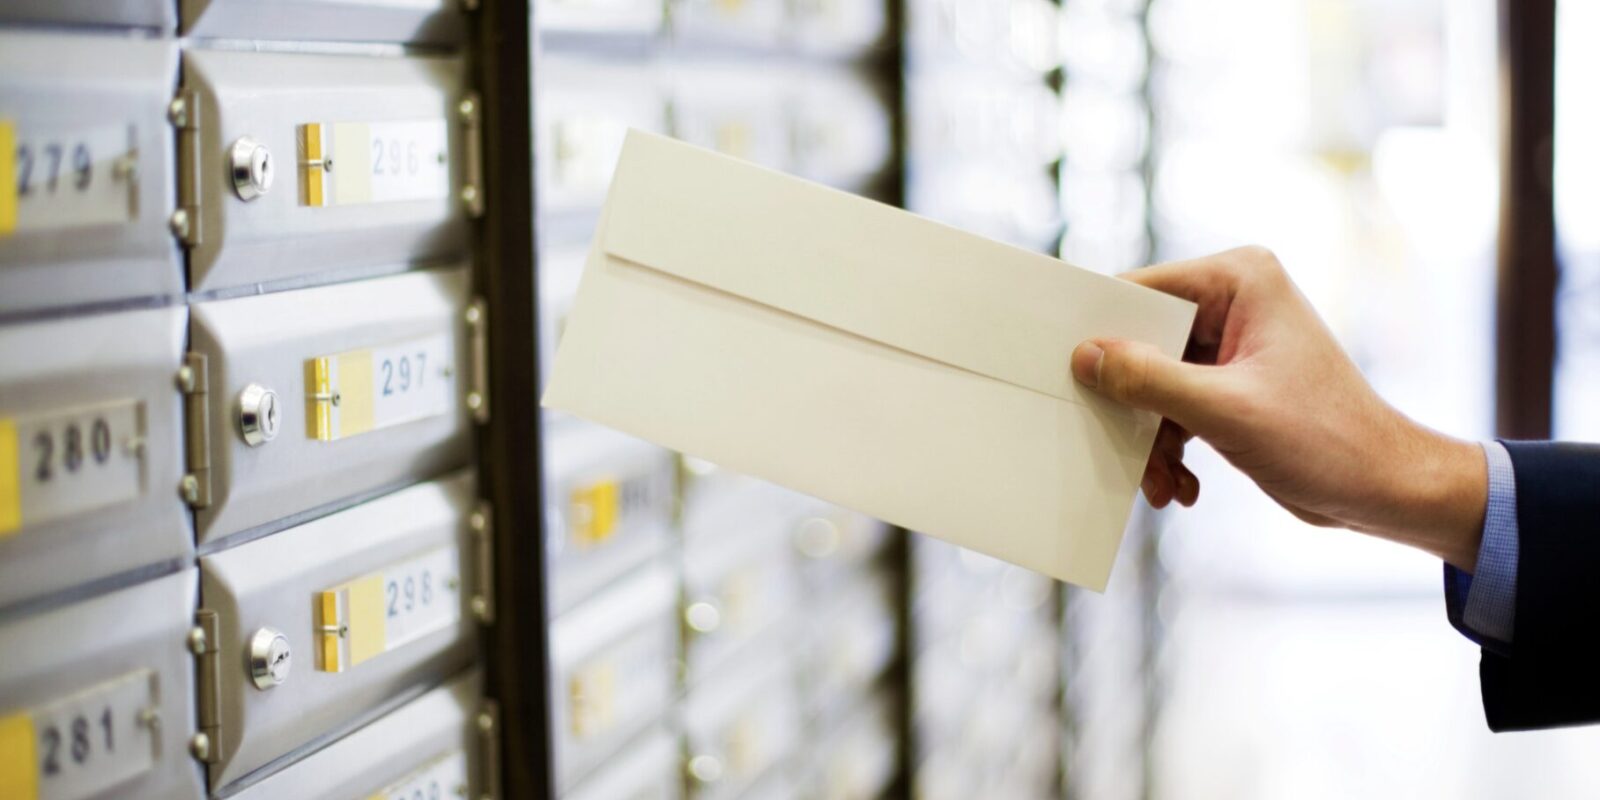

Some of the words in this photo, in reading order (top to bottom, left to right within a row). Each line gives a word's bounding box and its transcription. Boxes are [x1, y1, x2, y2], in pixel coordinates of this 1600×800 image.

[16, 143, 92, 196] 279
[371, 138, 419, 176] 296
[380, 352, 427, 397] 297
[33, 417, 111, 482] 280
[386, 571, 433, 618] 298
[40, 708, 114, 777] 281
